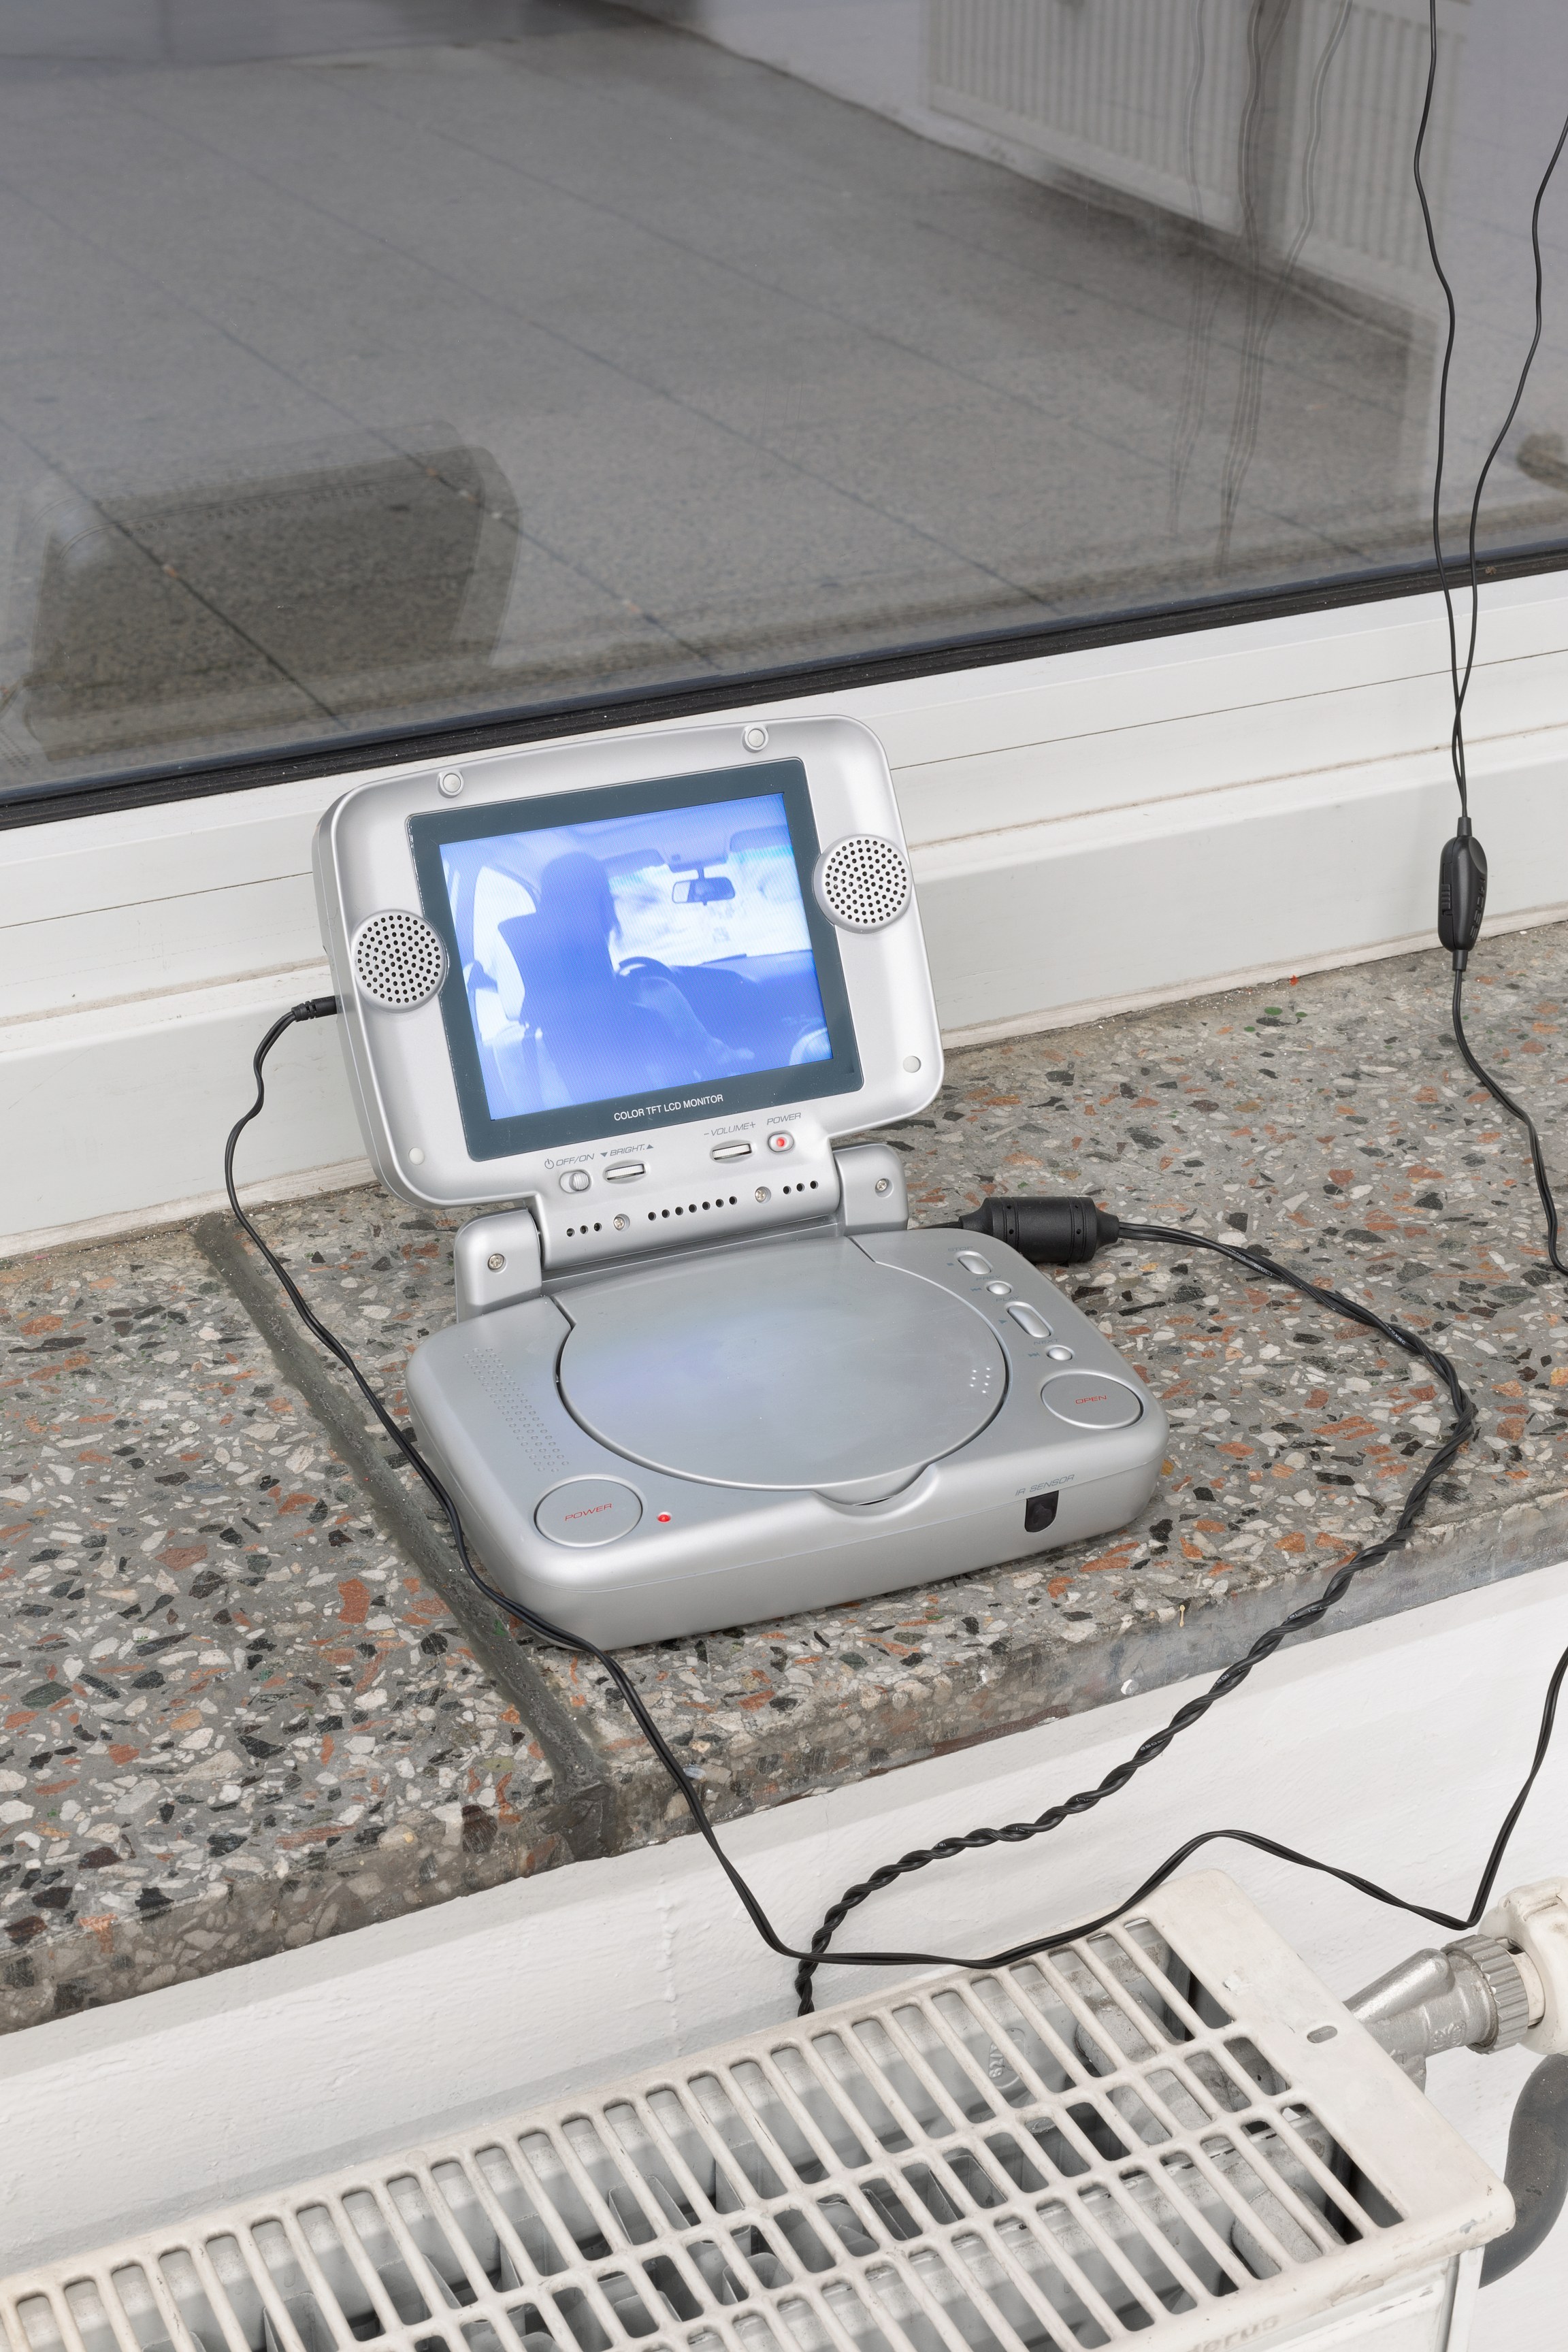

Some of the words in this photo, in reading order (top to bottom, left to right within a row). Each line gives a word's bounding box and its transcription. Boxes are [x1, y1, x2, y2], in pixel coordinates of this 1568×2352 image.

[614, 1108, 644, 1121] COLOR
[646, 1105, 662, 1115] TFT
[664, 1101, 681, 1112] LCD
[683, 1094, 723, 1109] MONITOR
[766, 1112, 802, 1126] POWER
[610, 1143, 645, 1156] BRIGHT.
[556, 1153, 595, 1166] OFF/ON
[1075, 1395, 1107, 1405] OPEN
[1015, 1488, 1026, 1497] IR
[1029, 1474, 1075, 1492] SENSOR
[565, 1503, 612, 1522] POWER
